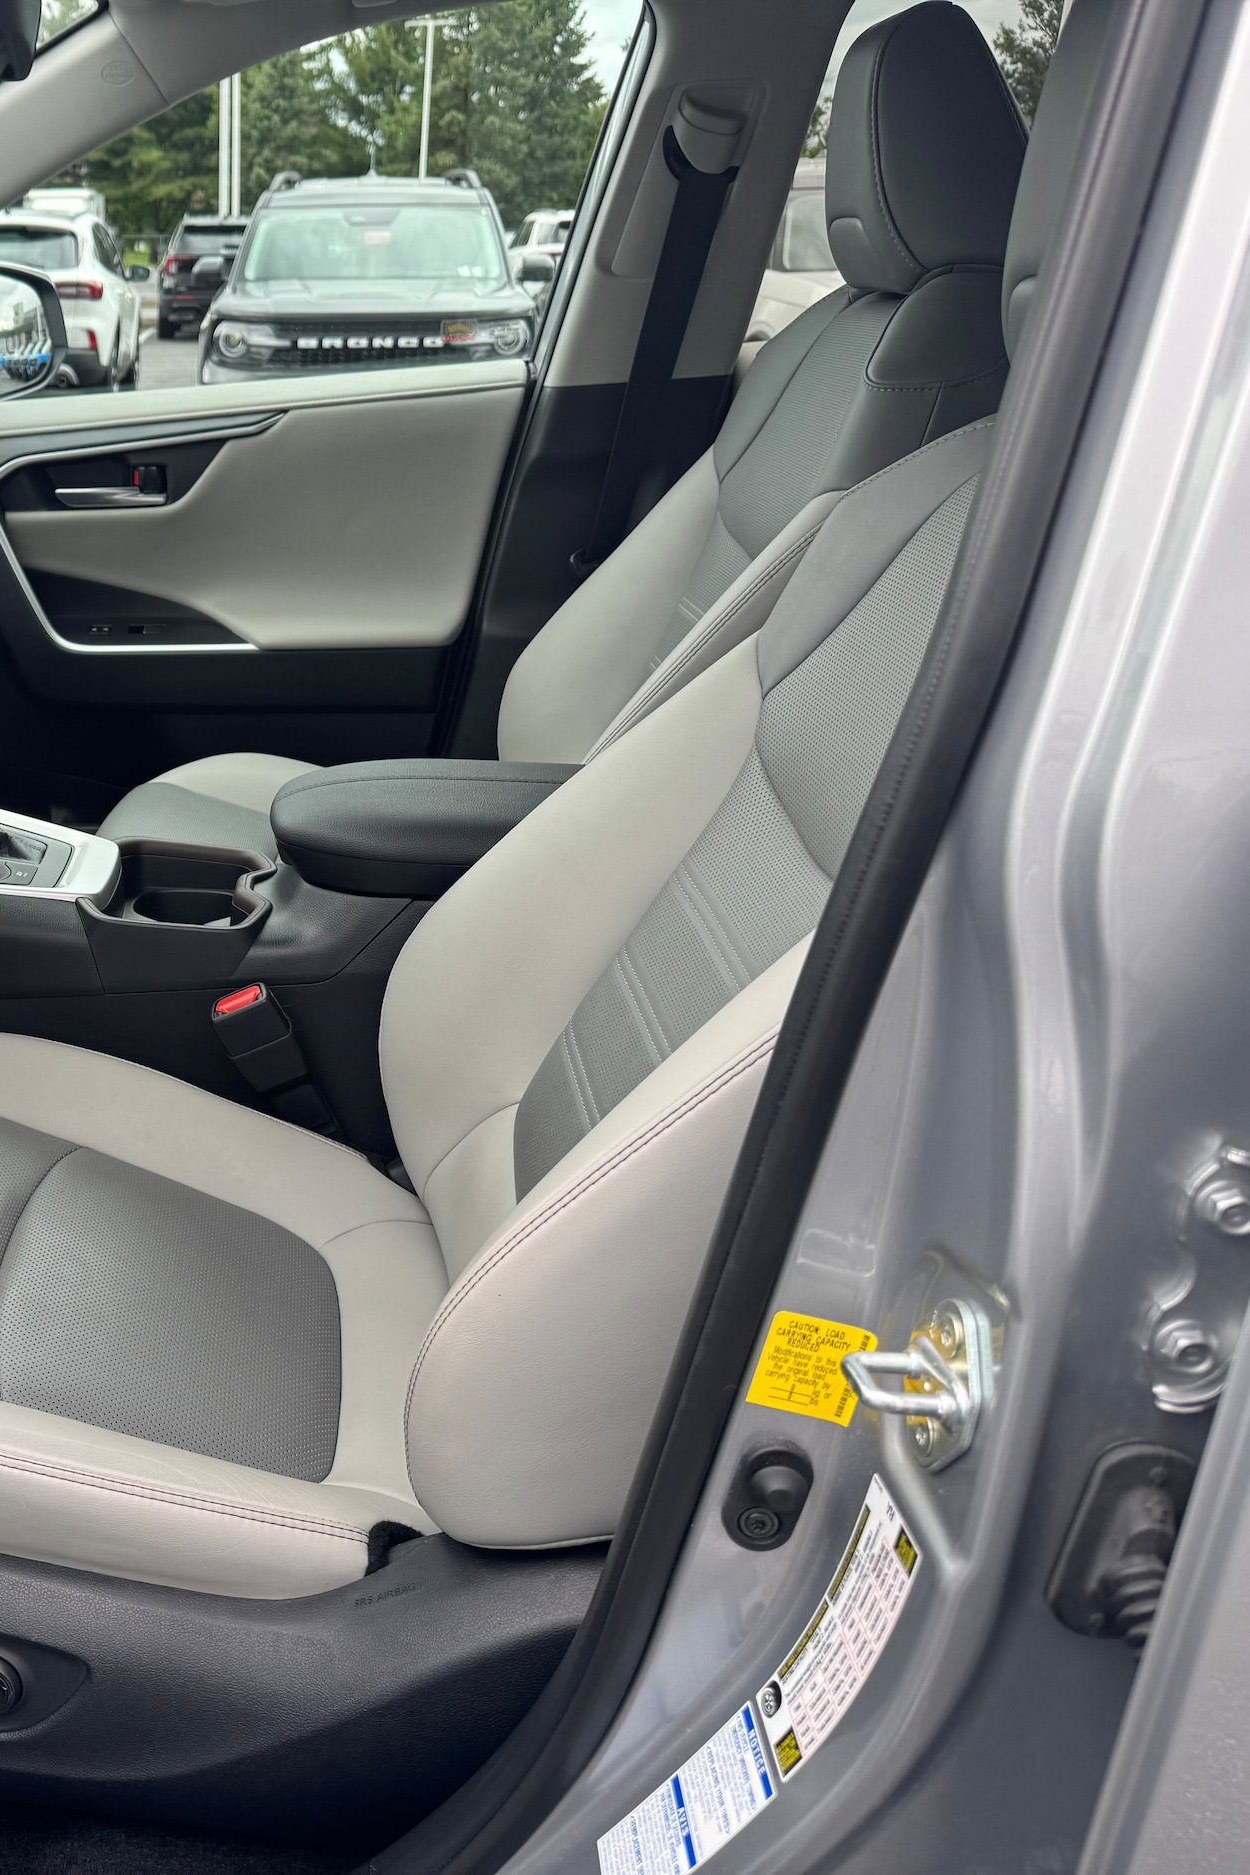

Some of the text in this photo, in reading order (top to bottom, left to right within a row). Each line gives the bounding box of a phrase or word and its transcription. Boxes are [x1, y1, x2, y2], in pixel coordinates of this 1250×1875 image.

[296, 336, 444, 350] BRONCO
[776, 1328, 851, 1350] CARRYING CAPACITY
[826, 1329, 846, 1339] LOAD
[787, 1338, 820, 1352] REDUCED
[748, 1729, 765, 1775] NOTICE
[676, 1806, 690, 1837] AVIS
